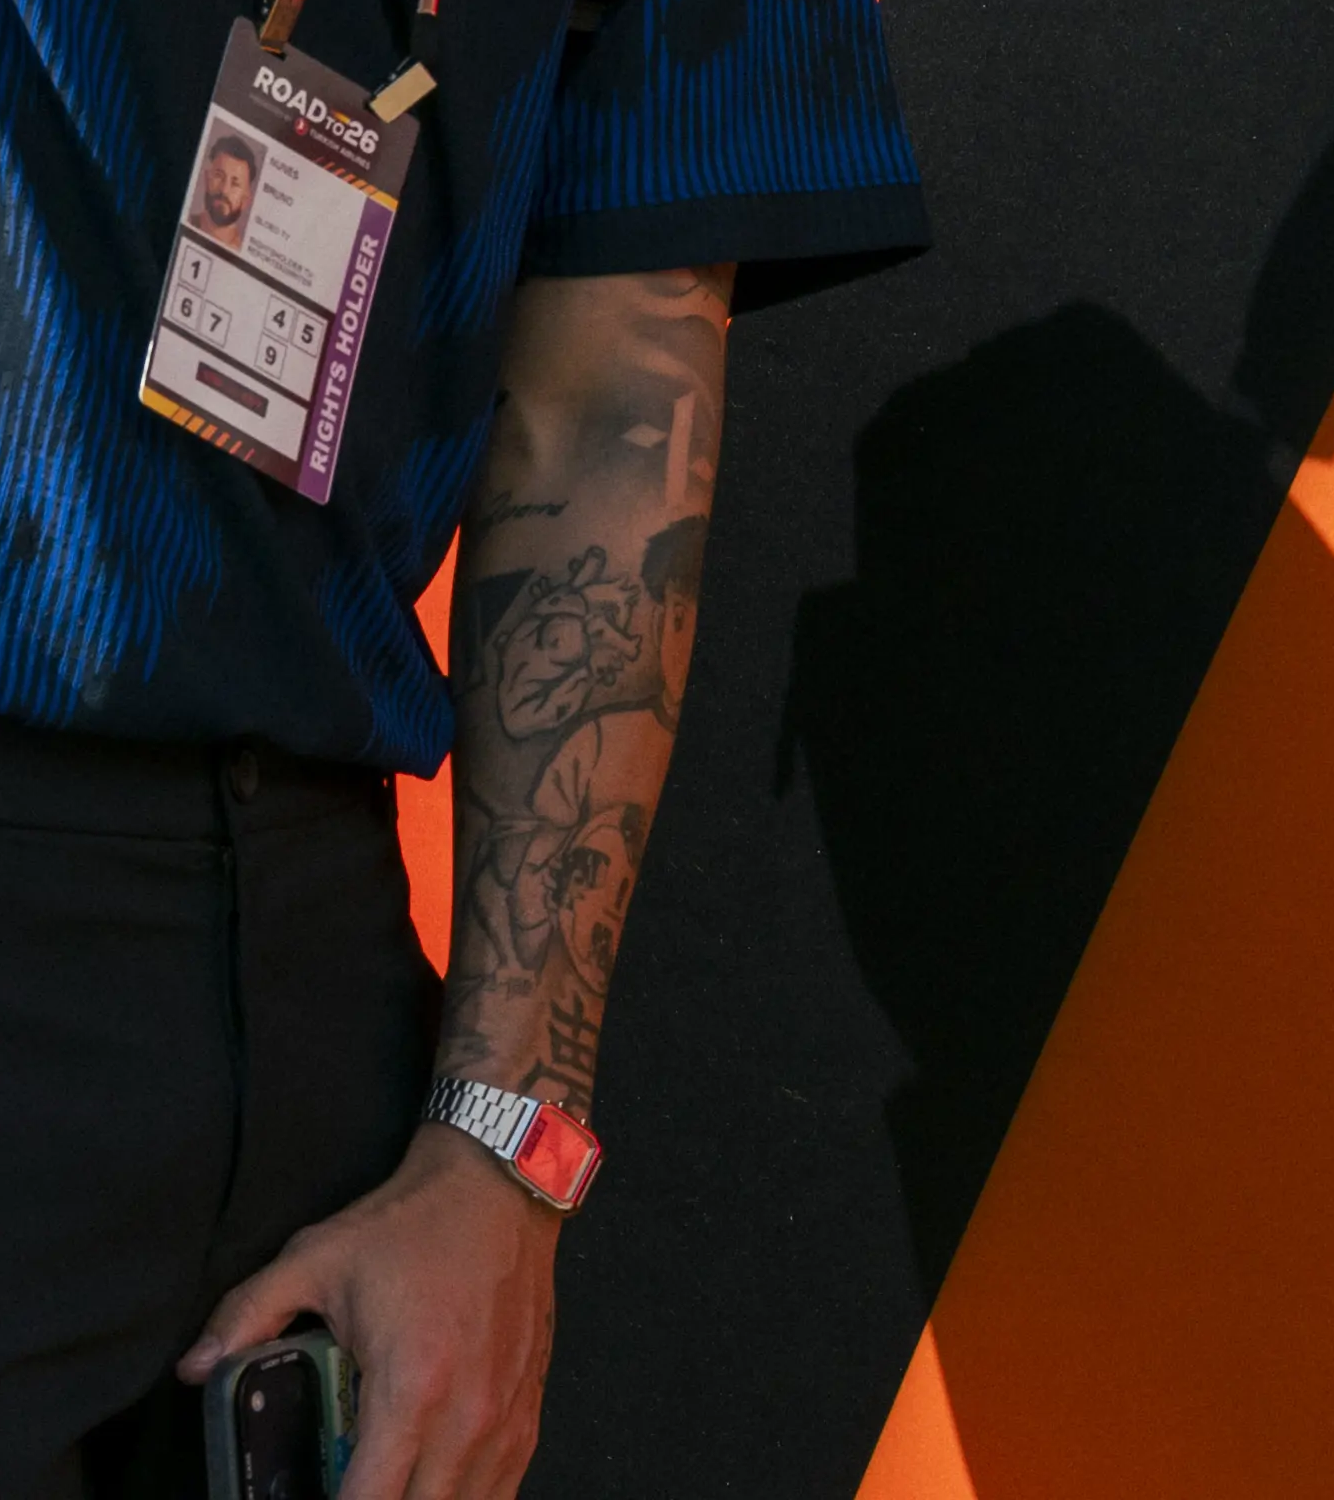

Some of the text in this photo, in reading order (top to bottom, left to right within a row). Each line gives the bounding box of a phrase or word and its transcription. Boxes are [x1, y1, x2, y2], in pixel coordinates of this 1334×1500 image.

[253, 66, 327, 123] ROAD
[325, 116, 345, 136] TO
[342, 120, 379, 154] 26
[191, 260, 200, 279] 1
[180, 298, 222, 332] 6 7
[272, 310, 314, 344] 4 5
[264, 346, 277, 366] 9
[309, 234, 379, 474] RIGHTS HOLDER
